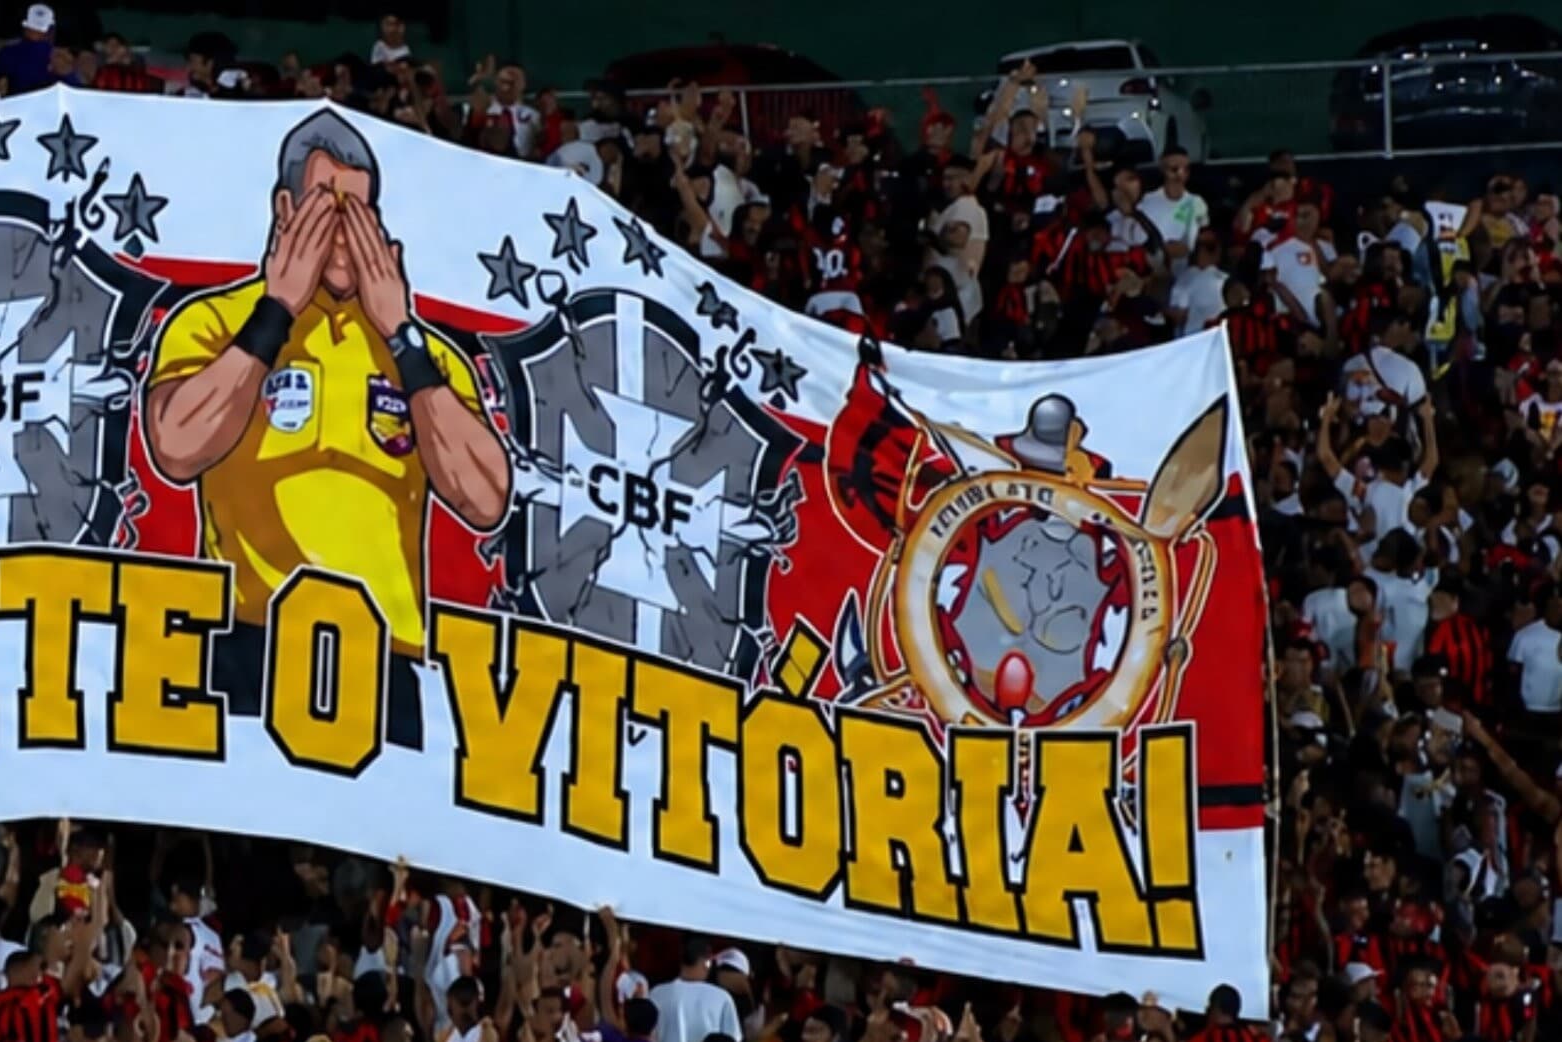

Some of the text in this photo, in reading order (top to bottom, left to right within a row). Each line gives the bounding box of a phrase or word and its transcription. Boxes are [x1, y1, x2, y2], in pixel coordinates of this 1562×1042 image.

[587, 464, 696, 535] CBF
[265, 566, 389, 776] O
[429, 602, 1205, 960] VITÓRIA!
